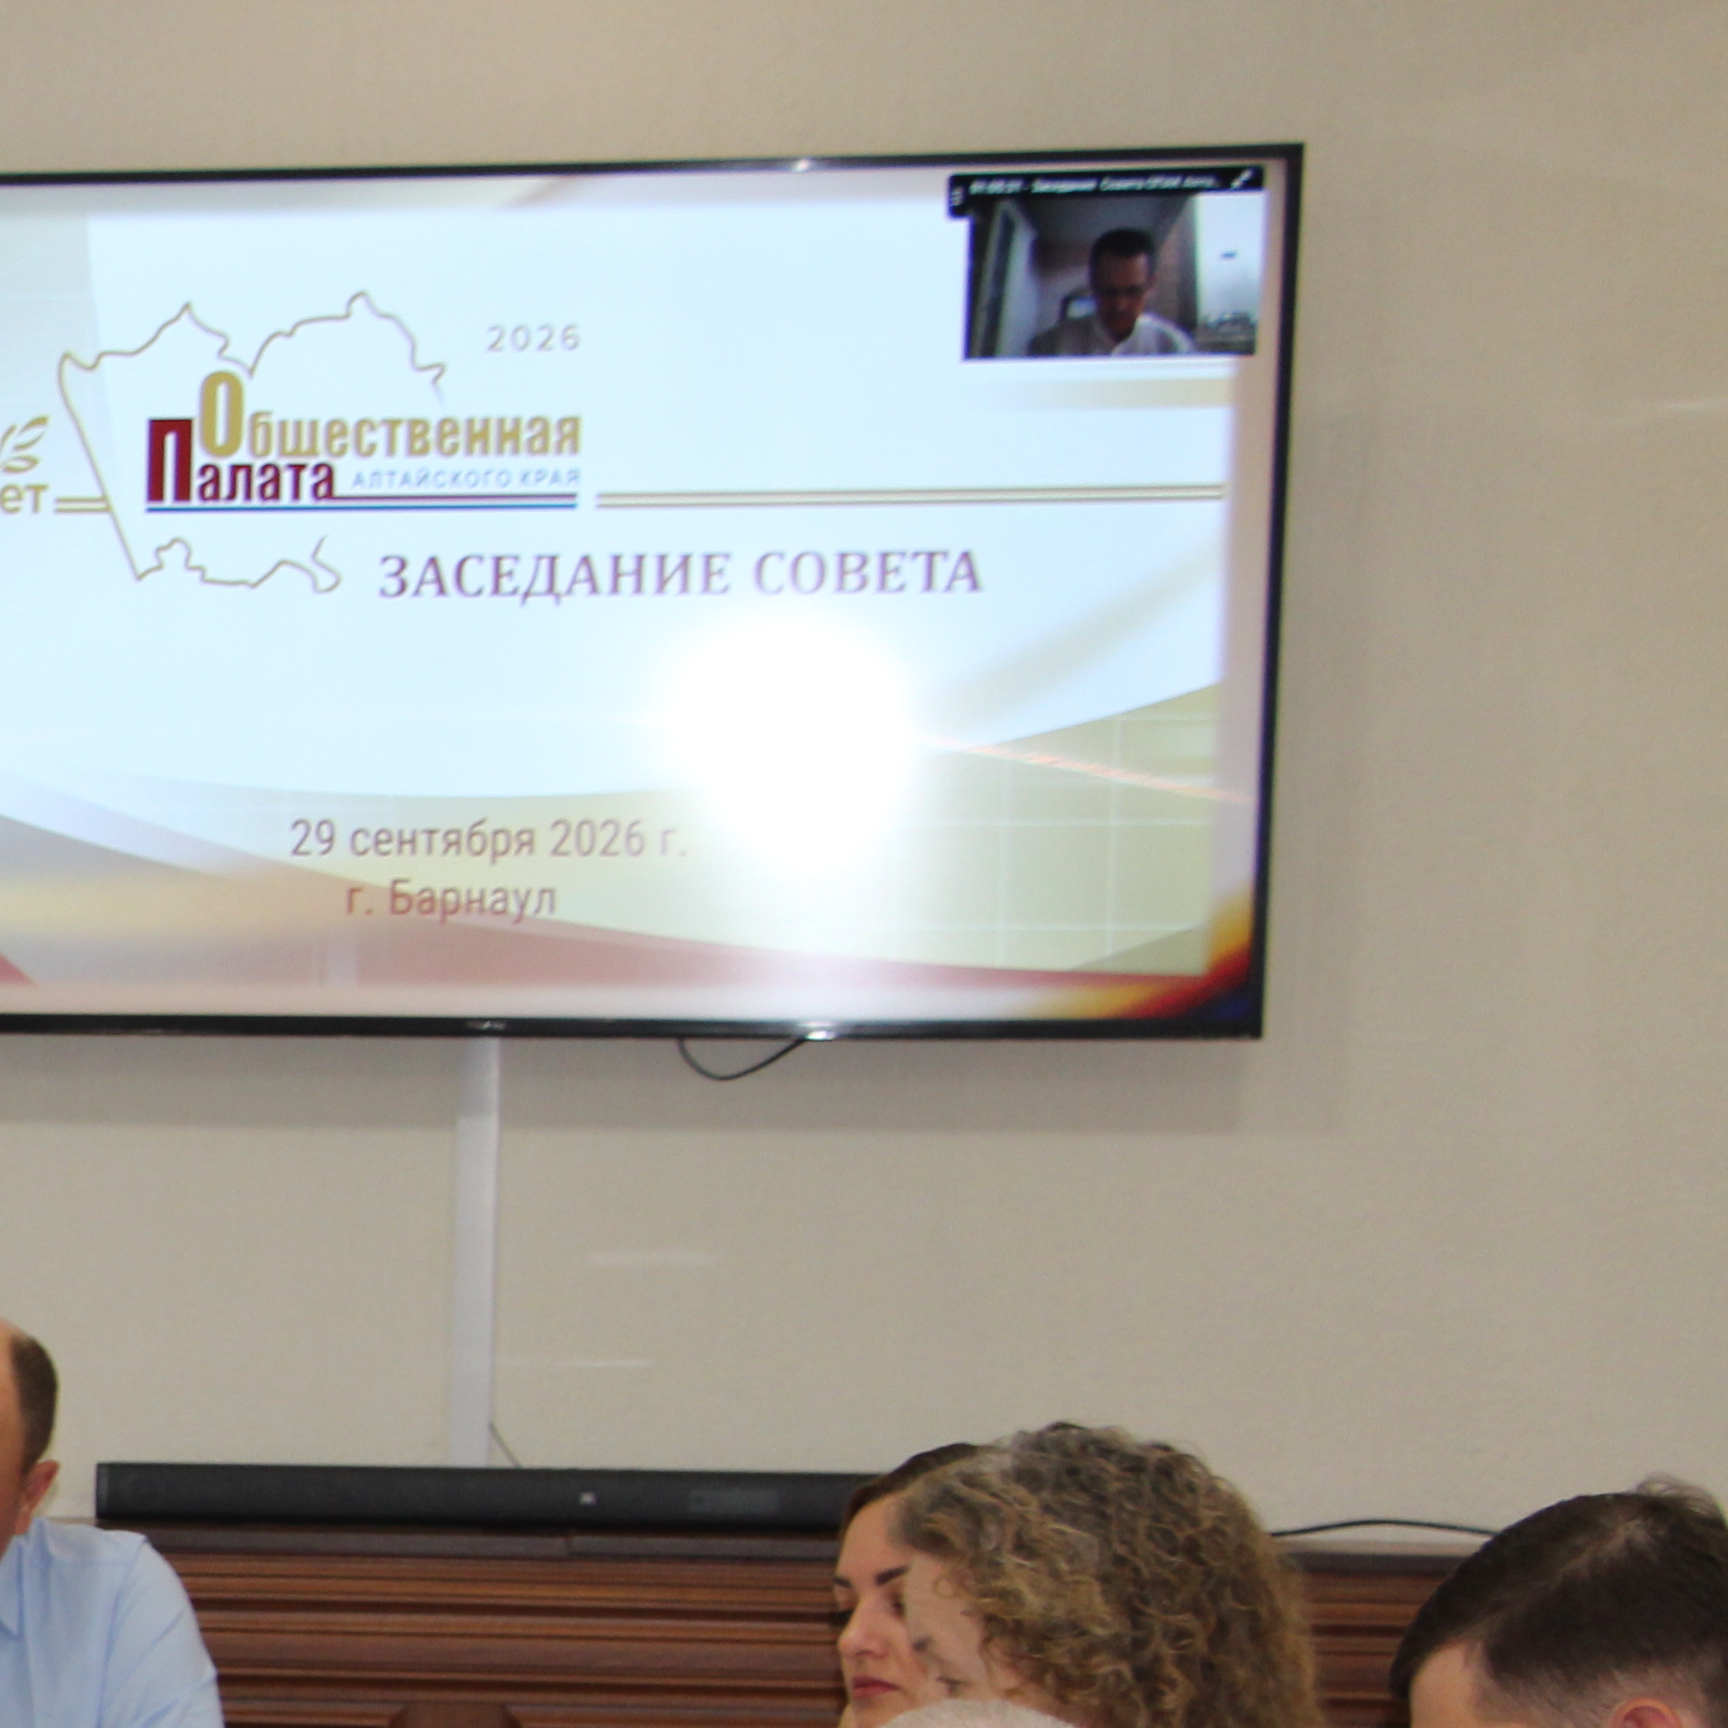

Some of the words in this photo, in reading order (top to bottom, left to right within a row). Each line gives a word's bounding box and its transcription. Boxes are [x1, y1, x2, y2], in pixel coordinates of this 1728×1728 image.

[487, 322, 582, 352] 2026
[199, 370, 582, 458] Общественная
[147, 418, 335, 503] Палата
[351, 468, 513, 490] АЛТАЙСКОГО
[519, 469, 581, 488] КРАЯ
[378, 552, 732, 606] ЗАСЕДАНИЕ
[753, 549, 983, 596] СОВЕТА
[290, 818, 335, 857] 29
[349, 817, 536, 864] сентября
[549, 818, 645, 857] 2026
[659, 828, 688, 857] г.
[346, 887, 374, 915] г.
[390, 877, 557, 924] Барнаул
